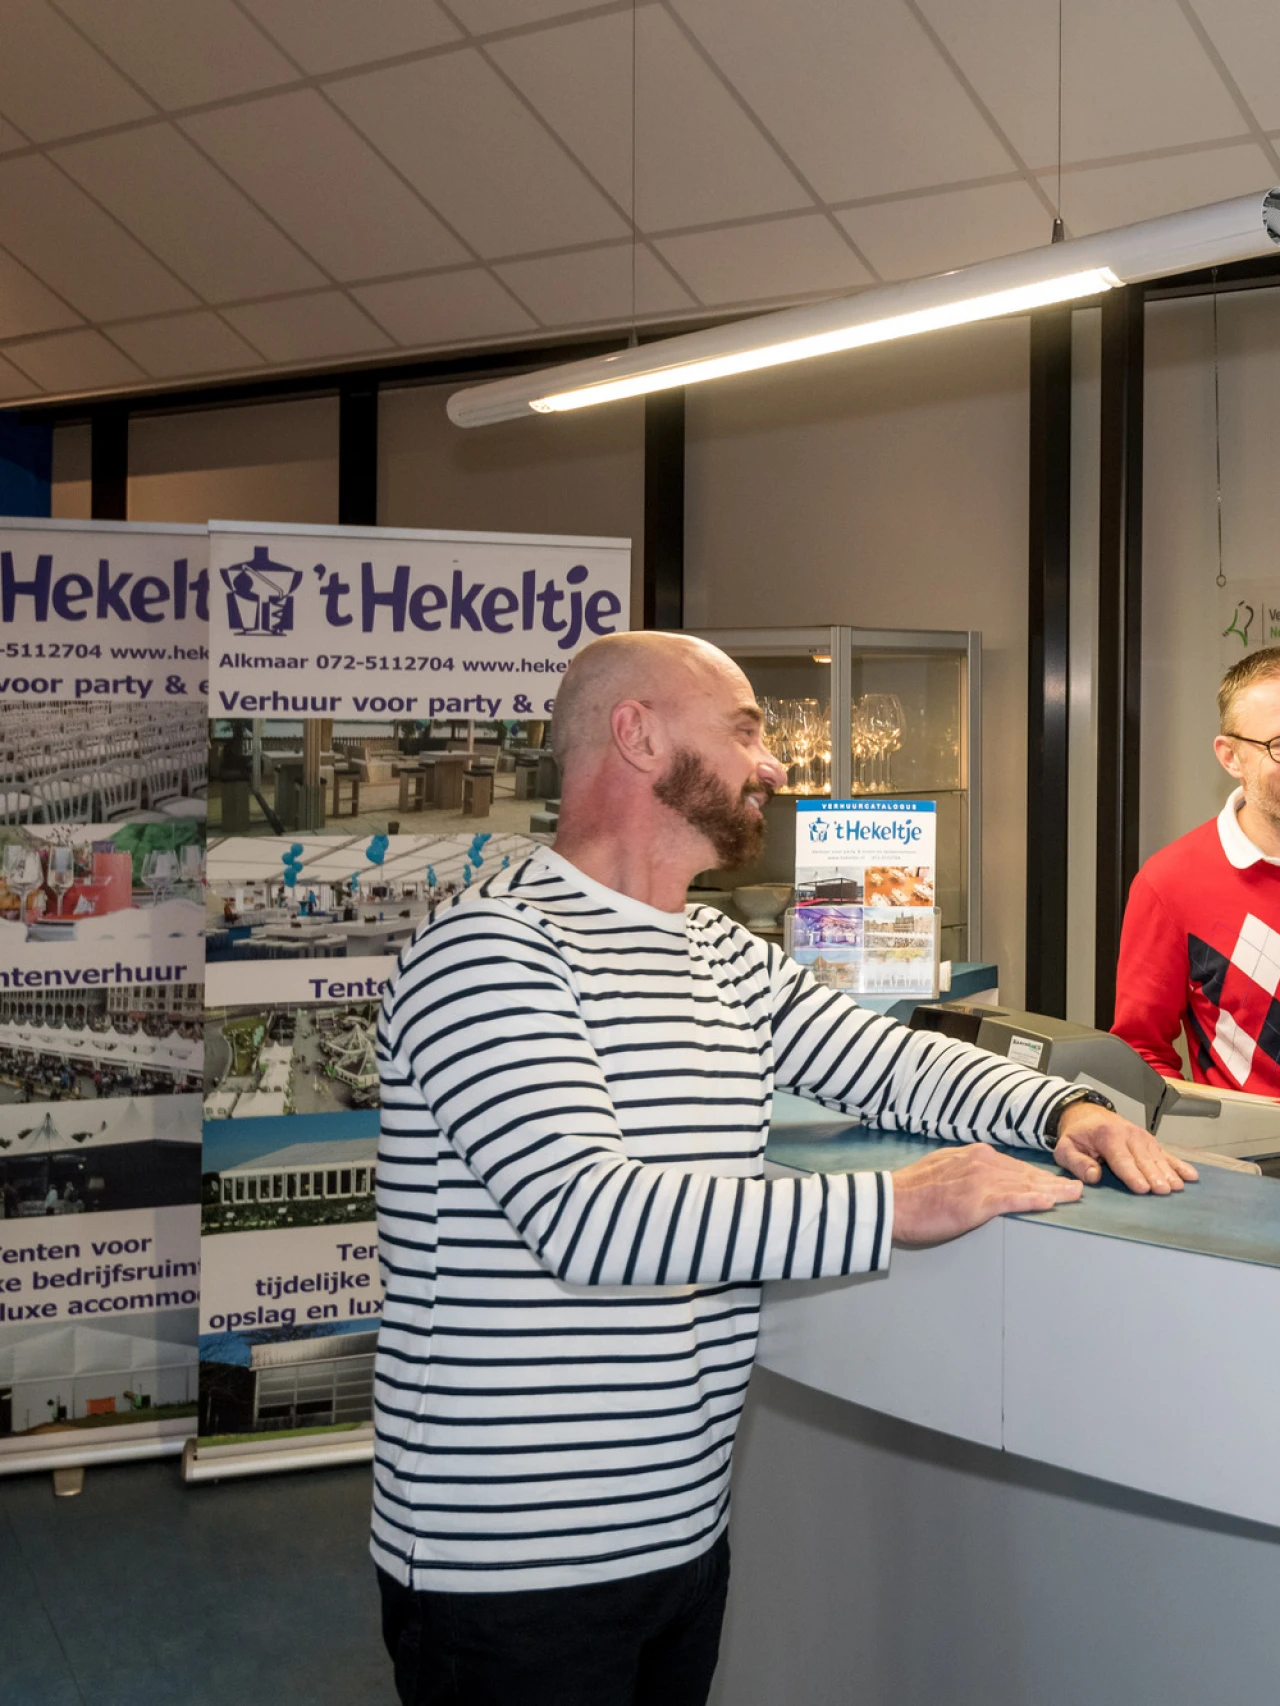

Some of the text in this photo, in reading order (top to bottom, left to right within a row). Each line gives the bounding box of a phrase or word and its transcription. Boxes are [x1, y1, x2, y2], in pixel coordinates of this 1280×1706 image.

[0, 551, 210, 623] Hekelt
[361, 562, 621, 650] Hekeltje
[0, 642, 209, 660] -5112704 www.hek
[219, 653, 573, 673] Alkmaar 072-5112704 www.heke
[75, 675, 154, 699] party
[165, 675, 188, 695] &
[219, 690, 343, 712] Verhuur
[352, 696, 418, 713] voor
[429, 694, 502, 718] party
[512, 694, 534, 714] &
[846, 818, 923, 845] Hekeltje
[0, 1237, 153, 1264] enten voor
[33, 1258, 201, 1290] bedrijfsruim
[256, 1271, 371, 1299] tijdelijke
[68, 1288, 201, 1316] accommo
[209, 1298, 385, 1332] opslag en lux
